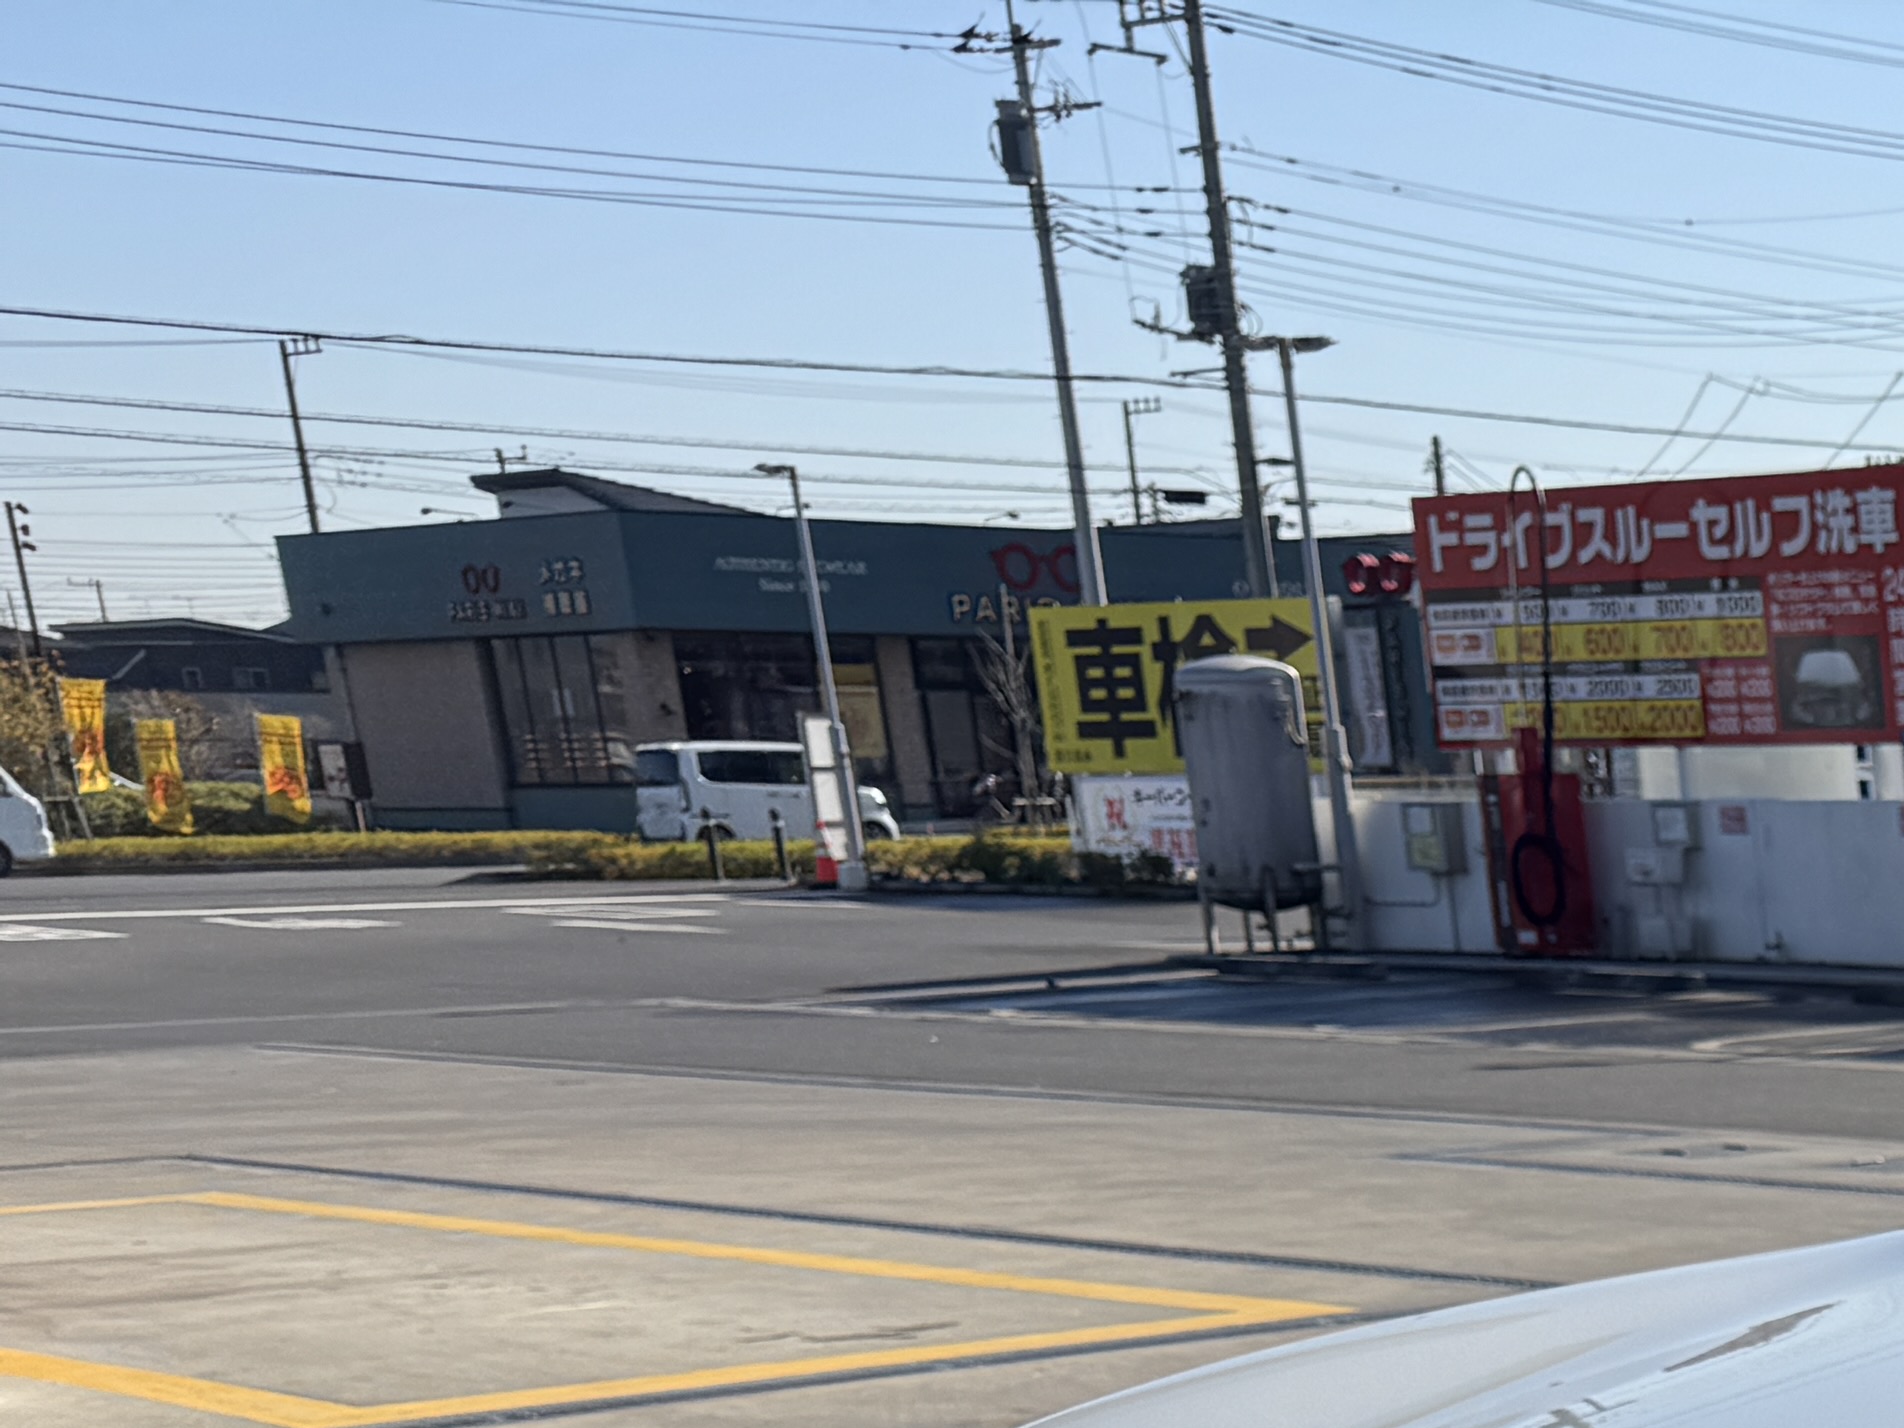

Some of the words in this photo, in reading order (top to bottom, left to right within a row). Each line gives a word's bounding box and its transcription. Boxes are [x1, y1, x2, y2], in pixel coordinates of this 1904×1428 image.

[1427, 484, 1902, 574] ドライブスルーセルフ洗車
